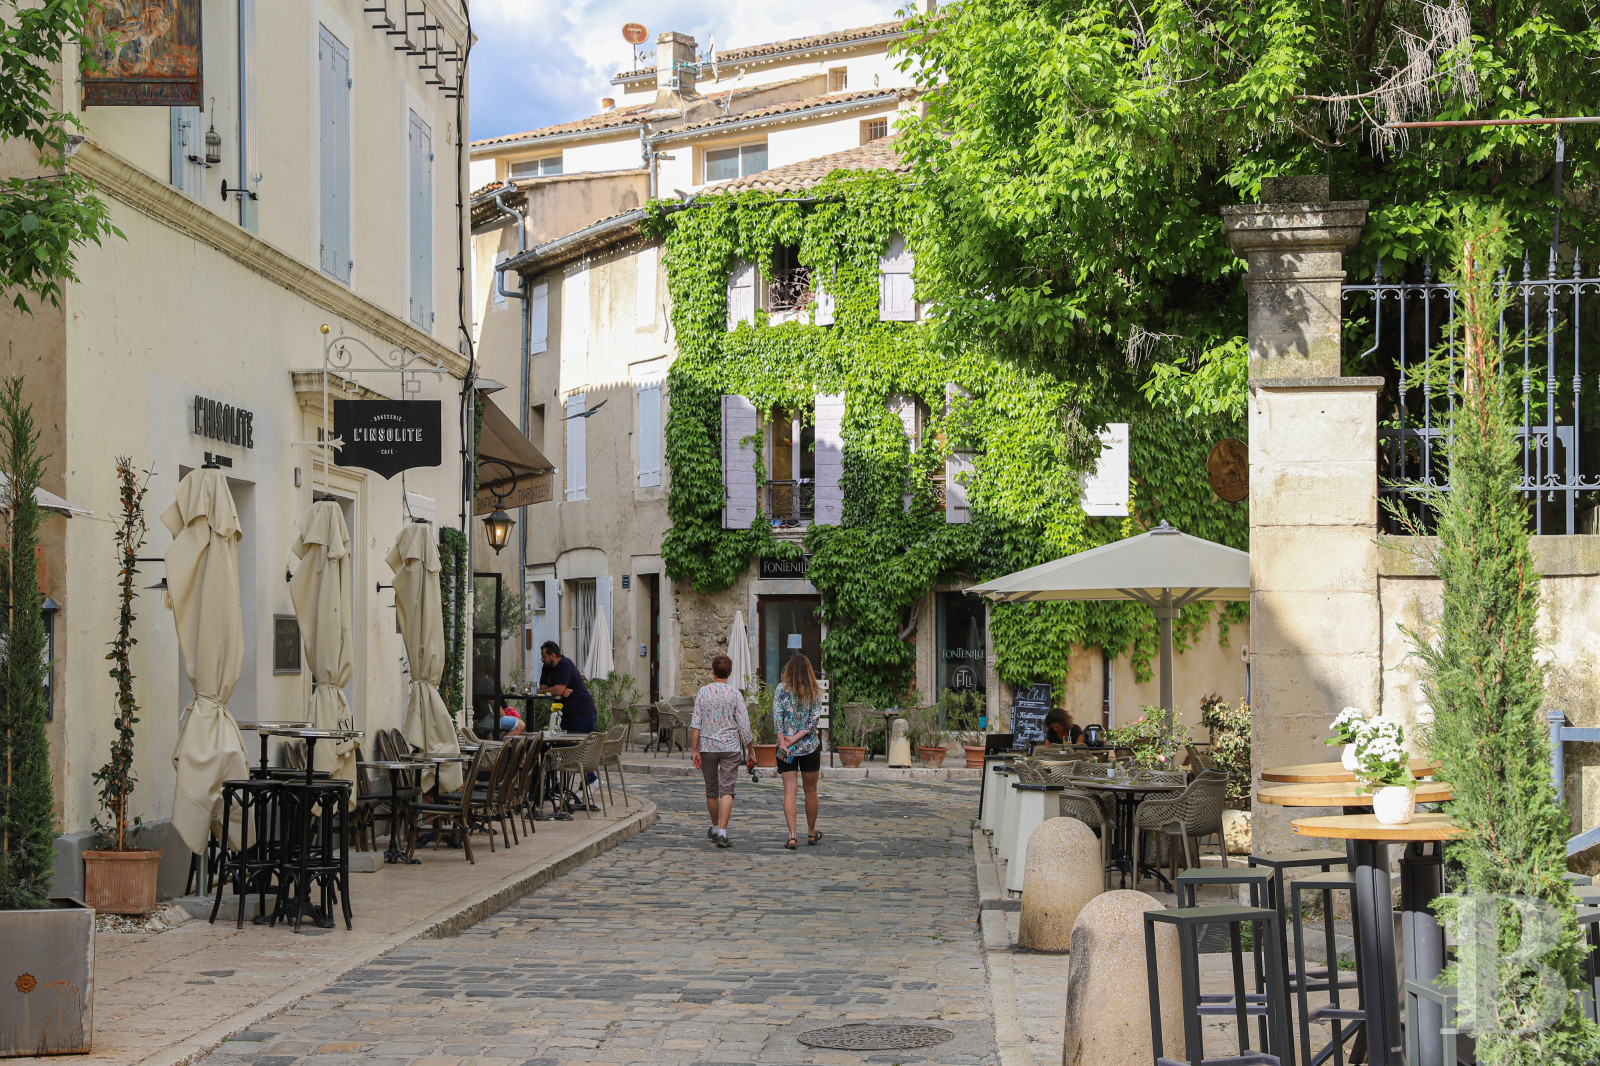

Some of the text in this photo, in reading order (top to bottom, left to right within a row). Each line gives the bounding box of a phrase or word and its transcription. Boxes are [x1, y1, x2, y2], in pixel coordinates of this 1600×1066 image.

[86, 83, 199, 100] RESTAURANT
[194, 395, 254, 449] L'INSOLITE
[373, 414, 403, 422] BRASSERIE
[353, 427, 423, 442] L'INSOLITE
[763, 560, 809, 574] FONTENILL
[942, 647, 986, 660] FONTENILLE
